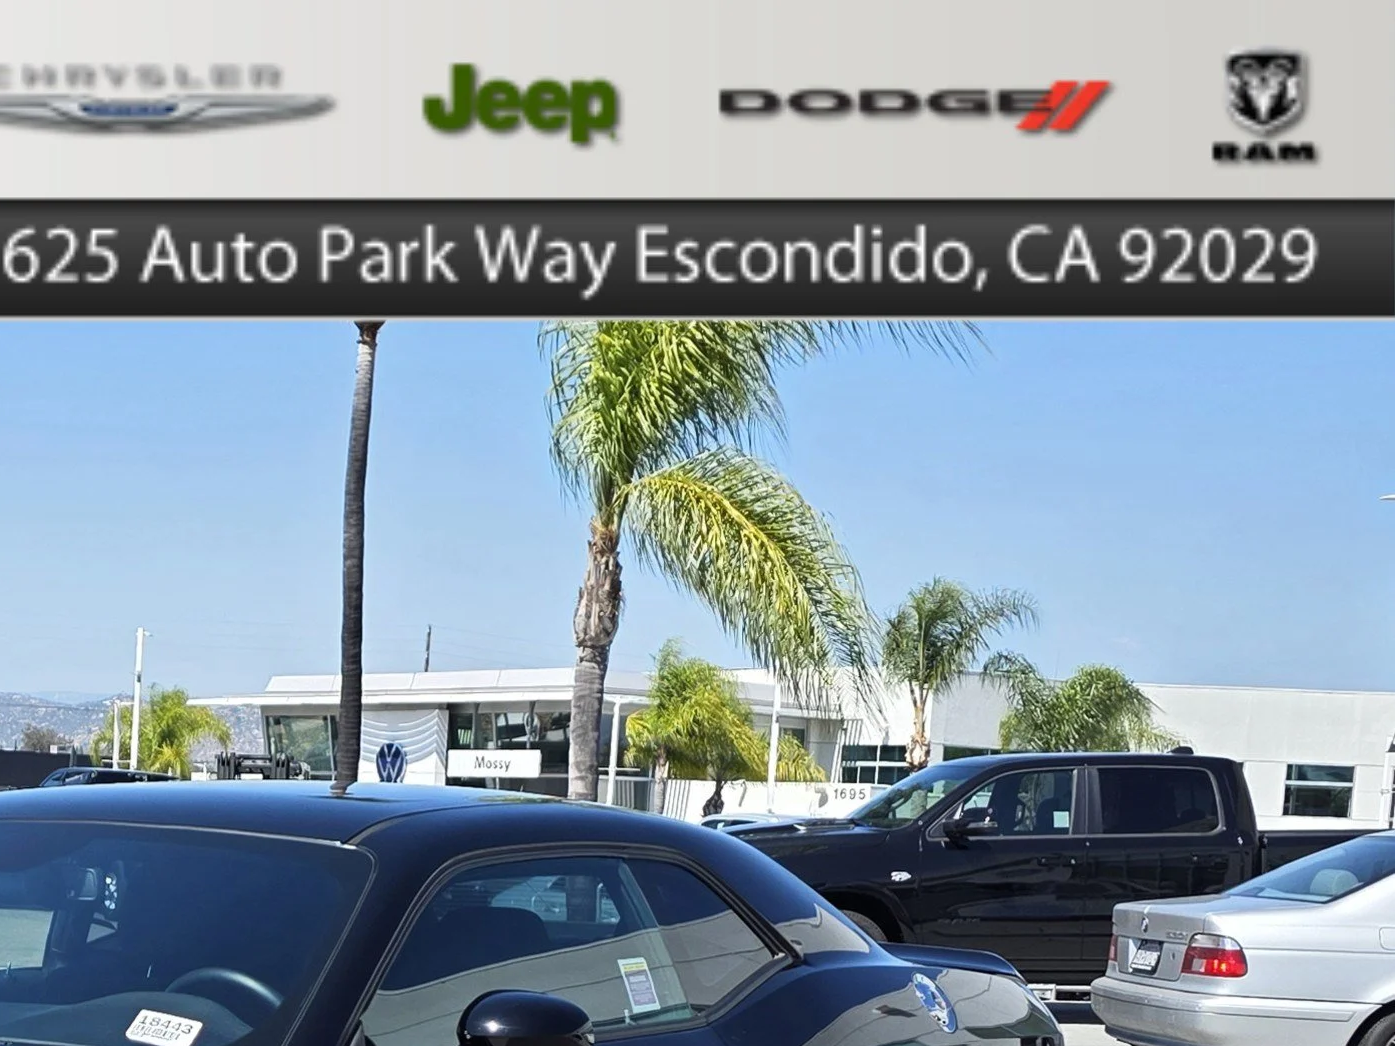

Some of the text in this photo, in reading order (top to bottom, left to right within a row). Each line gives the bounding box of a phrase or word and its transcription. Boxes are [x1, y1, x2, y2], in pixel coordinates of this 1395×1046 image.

[474, 756, 511, 772] Mossy
[834, 788, 866, 800] 1695
[138, 1015, 193, 1035] 18443
